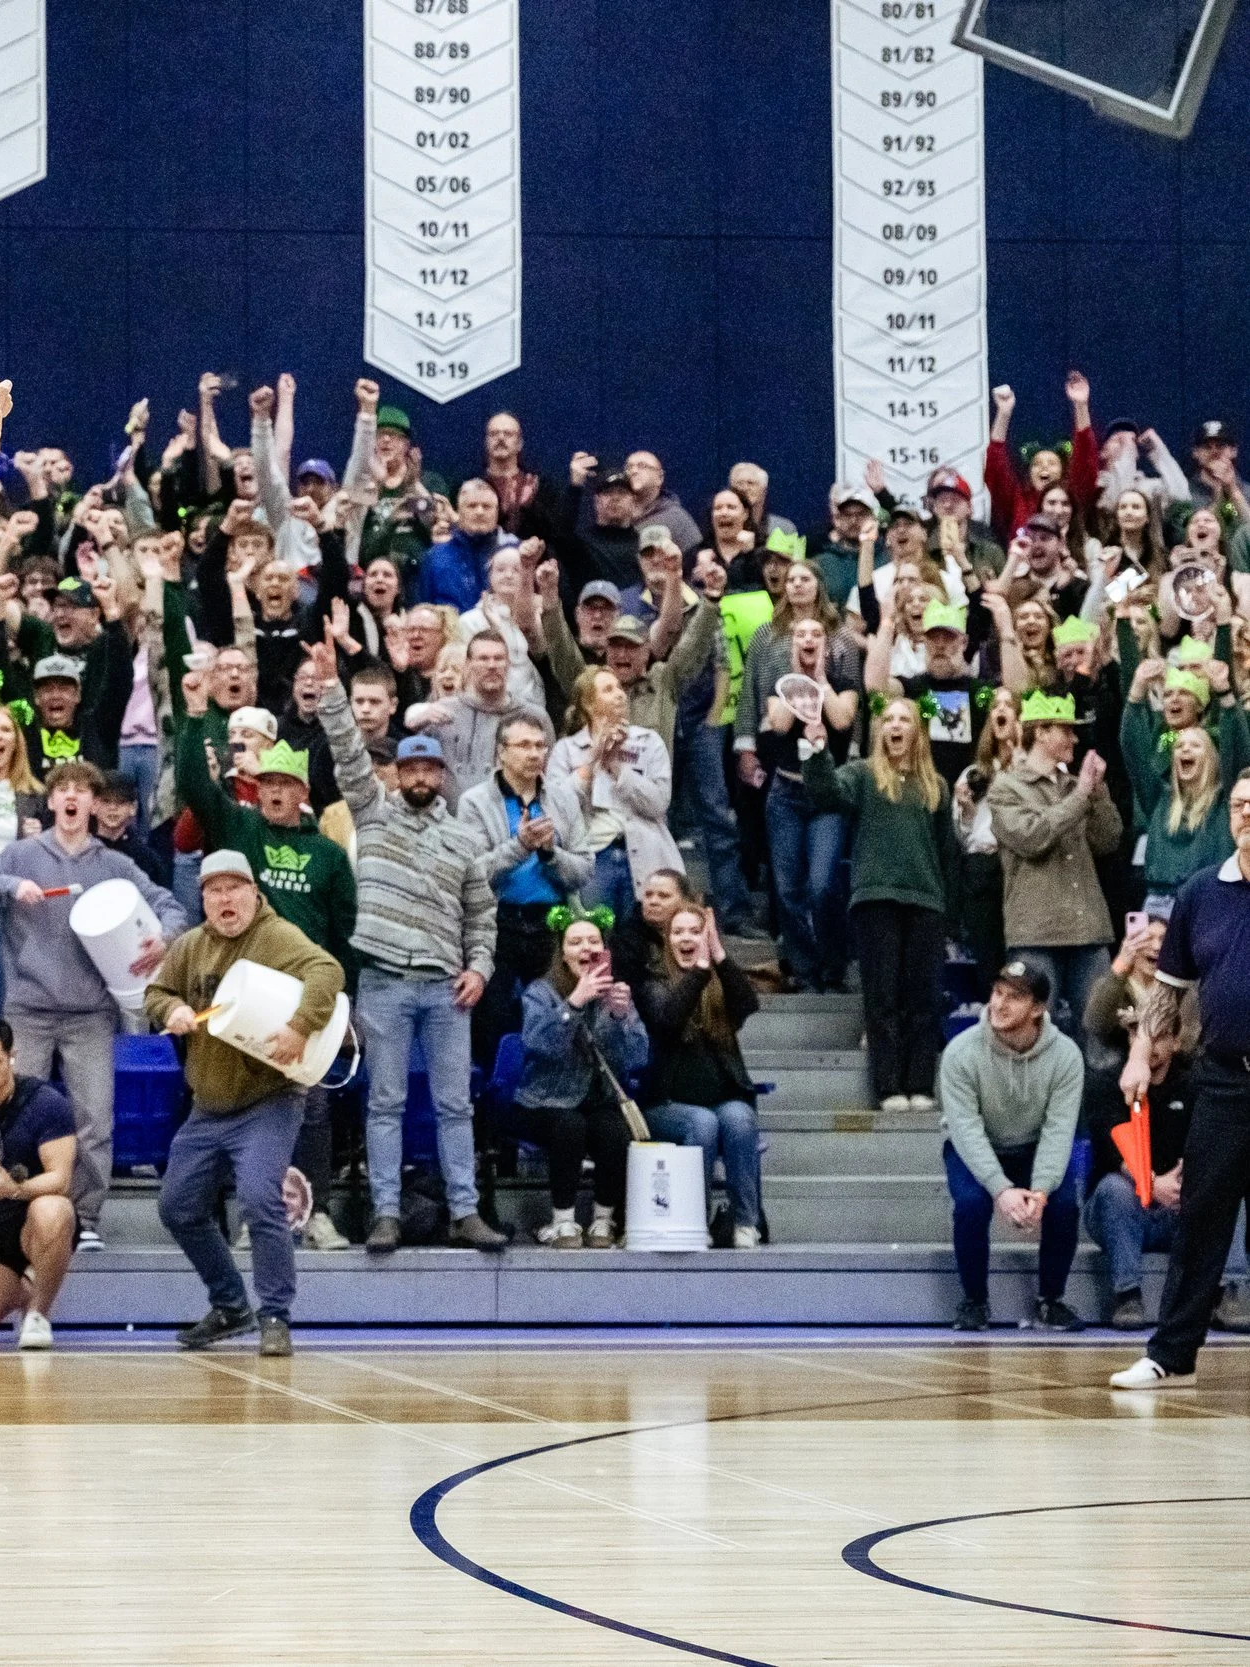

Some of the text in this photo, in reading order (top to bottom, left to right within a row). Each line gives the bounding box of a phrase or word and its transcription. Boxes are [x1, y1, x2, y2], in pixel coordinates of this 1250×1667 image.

[415, 86, 470, 104] 89/90
[416, 131, 469, 149] 01/02
[882, 135, 935, 152] 91/92
[415, 176, 471, 194] 05/06
[882, 179, 936, 197] 92/93
[418, 221, 469, 238] 10/11
[882, 223, 937, 241] 08/09
[419, 269, 469, 286] 11/12
[883, 268, 938, 286] 09/10
[415, 311, 472, 330] 14/15
[886, 313, 935, 330] 10/11
[416, 361, 469, 380] 18-19
[887, 356, 936, 373] 11/12
[887, 401, 938, 418] 14-15
[888, 447, 939, 464] 15-16
